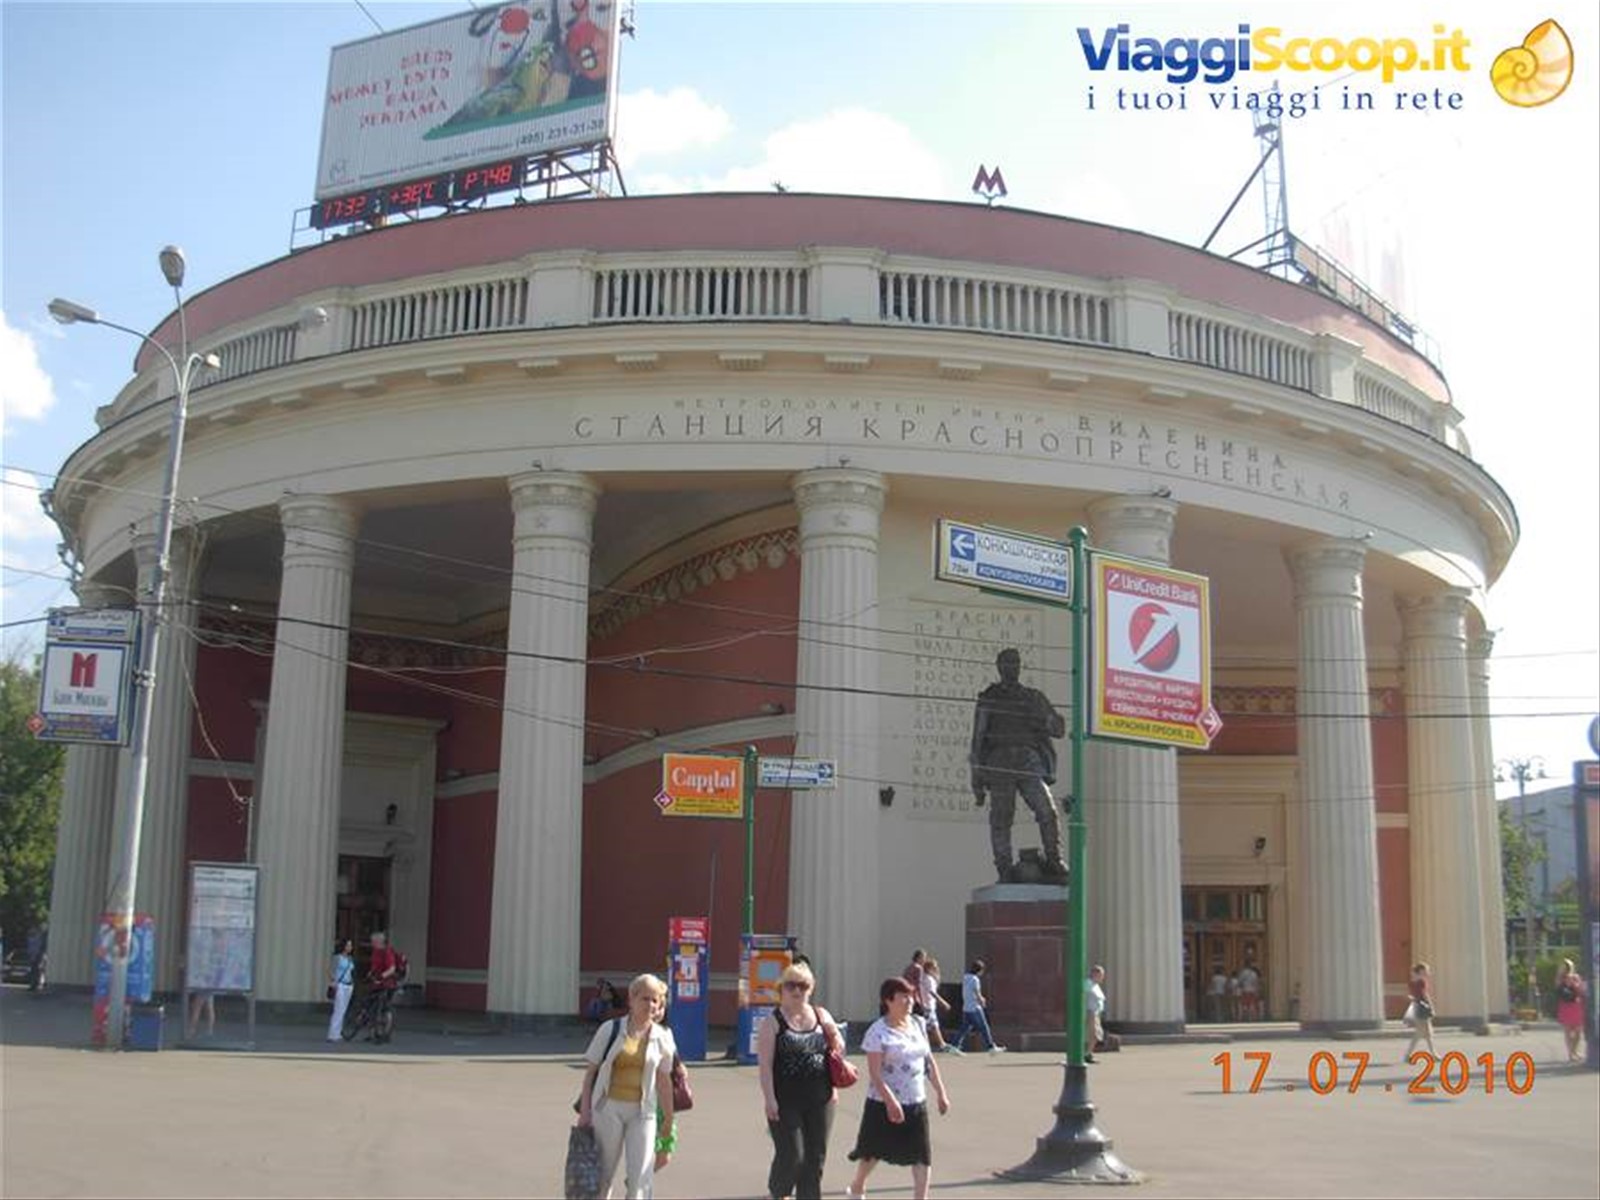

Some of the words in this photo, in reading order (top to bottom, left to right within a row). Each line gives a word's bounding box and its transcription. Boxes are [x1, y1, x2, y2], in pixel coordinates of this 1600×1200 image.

[574, 414, 823, 440] СТАНЦИЯ
[861, 416, 1351, 510] КРАСНОПРЕСНЕНСКАЯ
[1121, 572, 1170, 598] UniCredit
[1171, 585, 1199, 602] Bank
